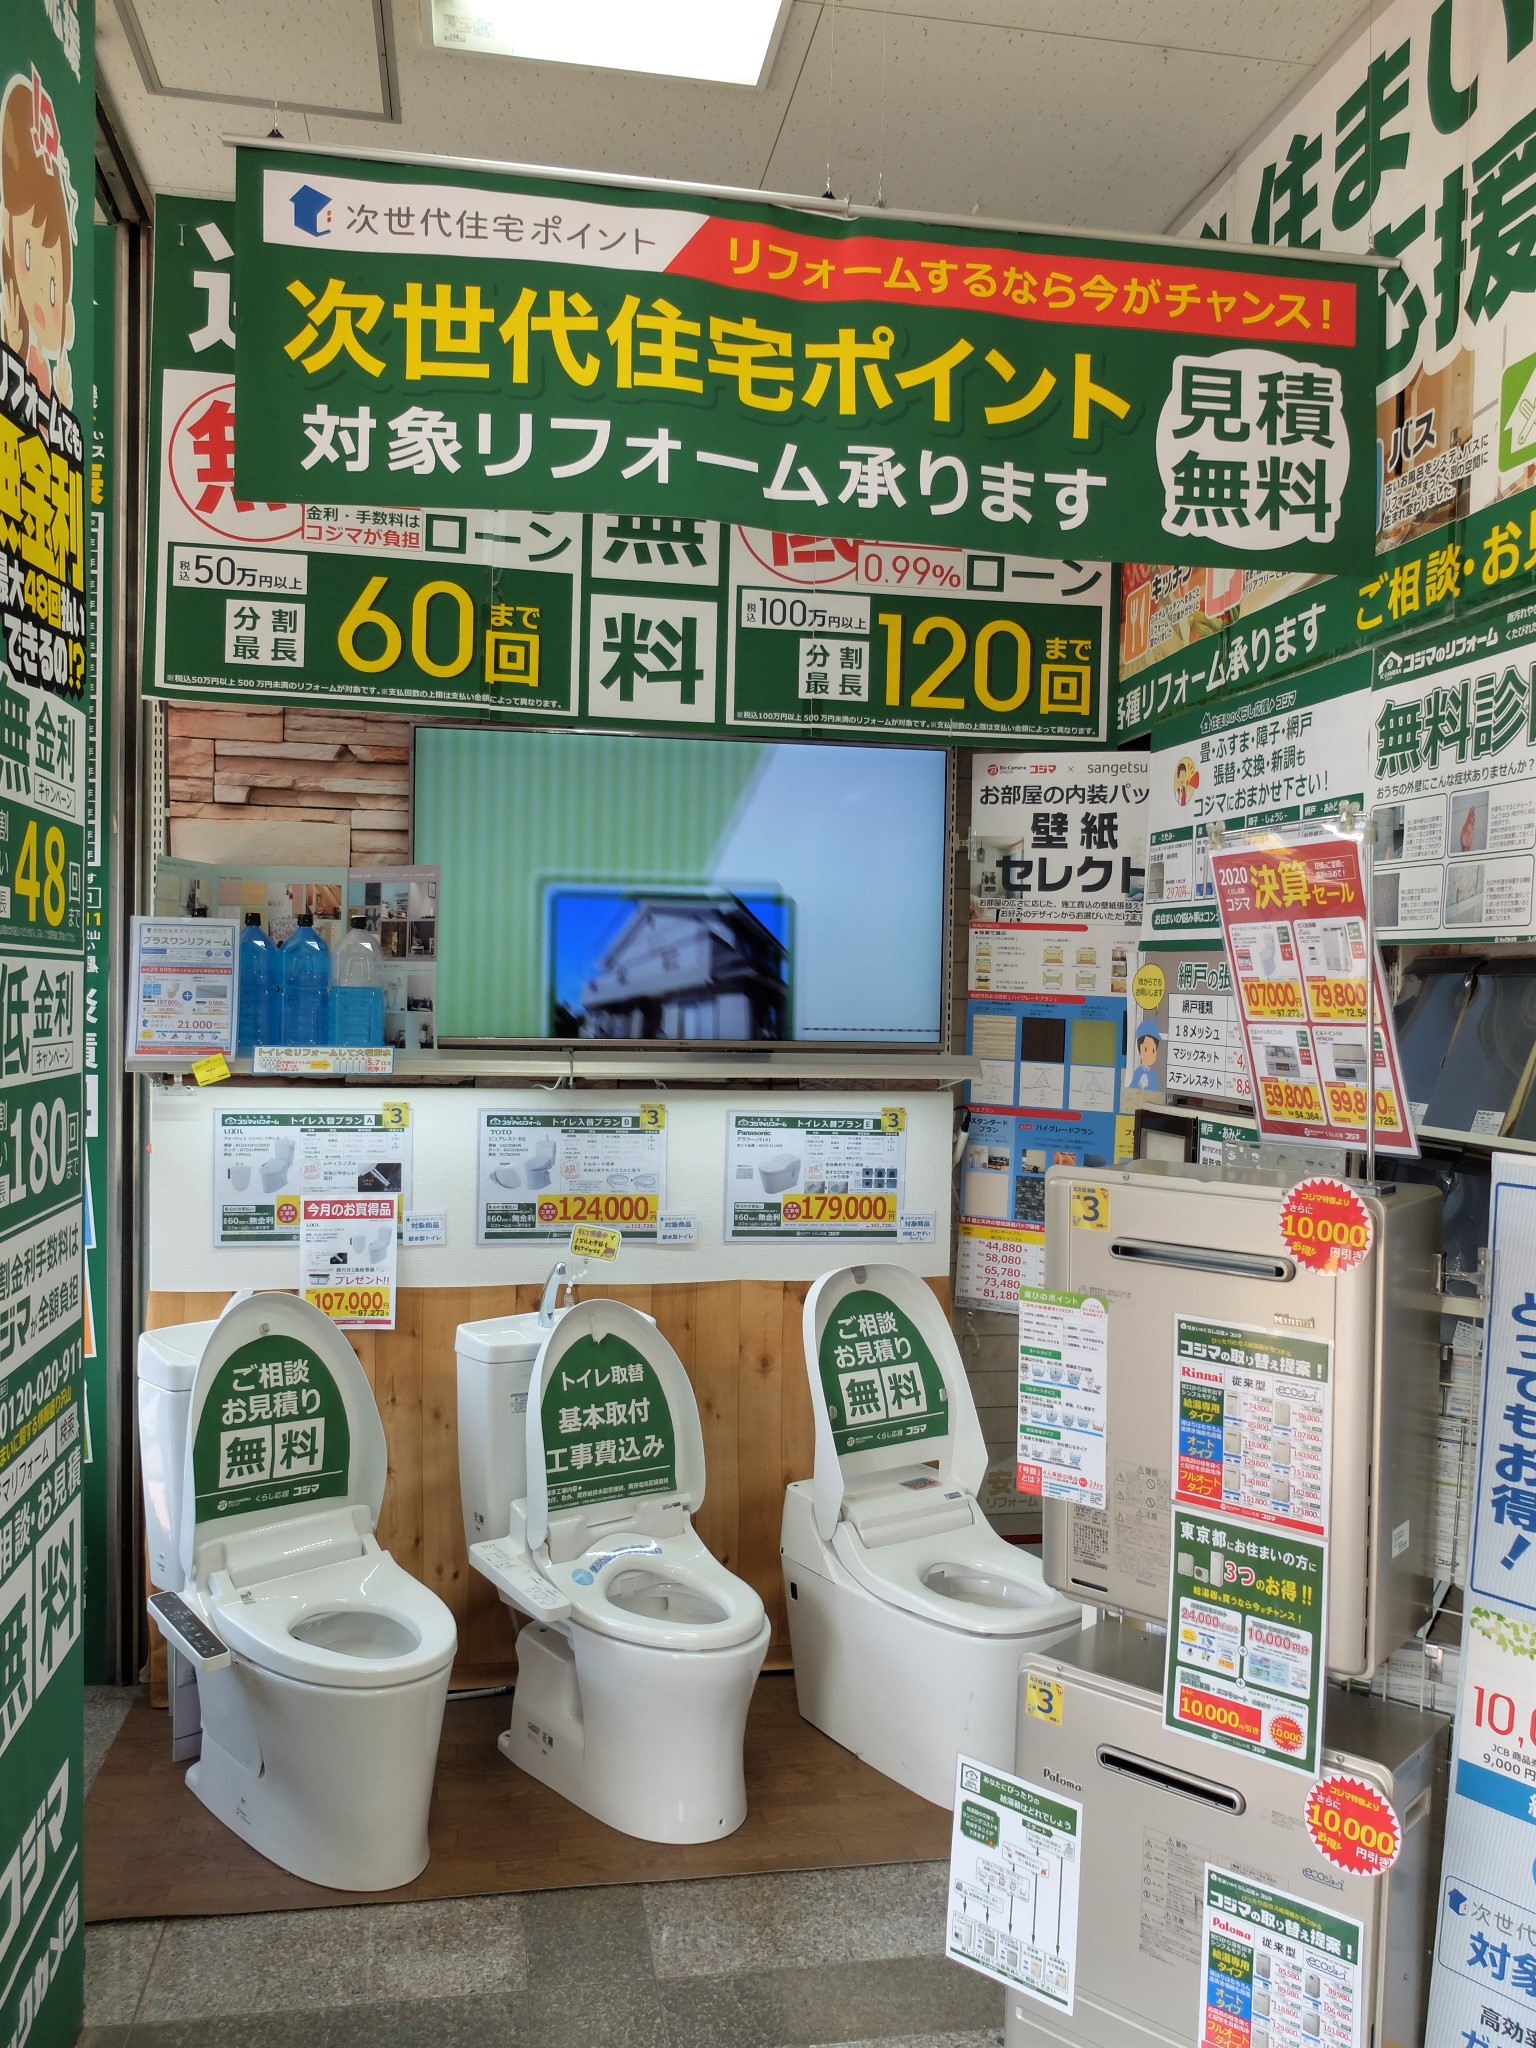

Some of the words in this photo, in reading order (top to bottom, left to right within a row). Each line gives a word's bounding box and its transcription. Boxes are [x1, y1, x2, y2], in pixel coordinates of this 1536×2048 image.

[346, 203, 656, 256] 次世代住宅ポイント
[728, 236, 1332, 330] リフォームするなら今がチャンス！
[284, 278, 1131, 440] 次世代住宅ポイント
[1172, 365, 1336, 450] 見積
[1388, 411, 1436, 472] バス
[300, 404, 1108, 532] 対象リフォーム承ります
[1385, 434, 1489, 497] 古いお風呂をシステムバスに
[1171, 449, 1333, 534] 無料
[306, 505, 421, 529] 金利・手数料は
[305, 524, 421, 549] コジマが負担
[425, 511, 573, 563] ローン
[194, 555, 303, 591] 50万円以上
[863, 552, 961, 588] 0.99%
[966, 553, 1103, 597] ローン
[1152, 566, 1193, 603] キッチン
[232, 606, 298, 634] 分割
[337, 575, 475, 679] 60
[490, 603, 541, 630] まで
[759, 597, 867, 631] 100万円以上
[232, 635, 298, 662] 最長
[485, 629, 541, 687] 回
[805, 644, 863, 671] 分割
[1403, 627, 1499, 674] コジマのリフォーム
[878, 613, 1034, 713] 120
[1044, 637, 1092, 661] まで
[237, 679, 255, 688] 500
[805, 671, 863, 697] 最長
[1040, 663, 1091, 716] 回
[1276, 690, 1297, 711] コジマ
[803, 714, 820, 722] 500
[1375, 661, 1536, 780] 無料診
[1200, 711, 1313, 764] 畳・ふすま・障子・網戸
[1030, 765, 1057, 774] コジマ
[1088, 762, 1148, 777] sangetsu
[1213, 745, 1306, 786] 張替・交換・新調も
[1376, 759, 1535, 800] おうちの外壁にこんな症状ありませんか？
[38, 781, 73, 810] キャンペーン
[979, 783, 1150, 805] お部屋の内装パッ
[1194, 770, 1328, 818] コジマにおまかせ下さい！
[1031, 812, 1119, 850] 壁紙
[15, 820, 66, 927] 48
[996, 855, 1146, 894] セレクト
[1218, 866, 1248, 886] 2020
[1250, 860, 1311, 910] 決算
[1226, 896, 1250, 912] コジマ
[1312, 882, 1355, 905] セール
[143, 936, 231, 947] プラスワンリフォーム
[0, 963, 74, 1079] 低金利
[1182, 1000, 1213, 1015] 網戸種類
[1175, 1025, 1220, 1041] 18メッシュ
[36, 1048, 71, 1071] キャンペーン
[1173, 1048, 1220, 1065] マジックネット
[1169, 1071, 1222, 1090] ステンレスネット
[290, 1116, 363, 1126] トイレ入替プラン
[390, 1107, 403, 1124] 3
[552, 1117, 620, 1127] トイレ入替プラン
[647, 1109, 659, 1126] 3
[797, 1119, 862, 1128] トイレ入替プラン
[888, 1112, 899, 1128] 3
[1035, 1124, 1094, 1135] ハイグレードプラン
[10, 1096, 67, 1200] 180
[249, 1216, 274, 1225] 無金利
[307, 1202, 391, 1217] 今月のお買得品
[512, 1214, 536, 1223] 無金利
[757, 1213, 781, 1222] 無金利
[1082, 1196, 1099, 1222] 3
[1289, 1201, 1313, 1215] さらに
[1282, 1214, 1367, 1248] 10,000
[1330, 1246, 1364, 1263] 円引き
[335, 1275, 390, 1286] プレゼント!!
[1024, 1290, 1079, 1306] 選びのポイント
[836, 1310, 899, 1340] ご相談
[1273, 1313, 1315, 1329] Rinnai
[833, 1336, 913, 1369] お見積り
[1180, 1340, 1323, 1380] コジマの取り替え提案！
[0, 1337, 82, 1440] 0120-020-911
[232, 1358, 311, 1393] ご相談
[561, 1363, 645, 1392] トイレ取替
[1181, 1366, 1224, 1384] Rinnai
[1232, 1374, 1266, 1392] 従来型
[221, 1387, 321, 1426] お見積り
[845, 1369, 922, 1417] 無料
[1183, 1398, 1220, 1414] 給湯専用
[558, 1397, 650, 1434] 基本取付
[1188, 1410, 1215, 1423] タイプ
[876, 1429, 903, 1441] くらし応援
[906, 1423, 927, 1436] コジマ
[1187, 1436, 1215, 1449] オート
[225, 1424, 320, 1480] 無料
[546, 1433, 665, 1475] 工事費込み
[1187, 1446, 1213, 1459] タイプ
[1180, 1470, 1222, 1488] フルオート
[1187, 1482, 1213, 1496] タイプ
[256, 1489, 289, 1502] くらし応援
[293, 1484, 320, 1497] コジマ
[986, 1496, 1038, 1509] リフォーム
[1180, 1521, 1317, 1573] 東京都にお住まいの方に
[1223, 1561, 1313, 1606] 3つのお得!!
[1193, 1585, 1302, 1624] 給湯器を買うなら今がチャンス！
[1037, 1687, 1054, 1715] 3
[1474, 1685, 1536, 1749] 10,
[1483, 1752, 1521, 1776] 9,000
[1492, 1744, 1510, 1757] JCB
[982, 1775, 1040, 1806] あなたにぴったりの
[1043, 1767, 1082, 1793] Paloma
[1000, 1793, 1072, 1831] 給湯器はどれでしょう
[1316, 1791, 1342, 1811] さらに
[1329, 1786, 1380, 1812] コジマ特価より
[1025, 1821, 1047, 1836] スタート
[1308, 1803, 1394, 1855] 10,000
[1355, 1845, 1391, 1869] 円引き
[1209, 1890, 1353, 1960] コジマの取り替え提案！
[1212, 1917, 1251, 1941] Paloma
[1261, 1936, 1296, 1959] 従来型
[1211, 1948, 1250, 1972] 給湯専用
[1217, 1962, 1244, 1979] タイプ
[1215, 1988, 1243, 2005] オート
[1215, 1999, 1242, 2015] タイプ
[1207, 2021, 1250, 2045] フルオート
